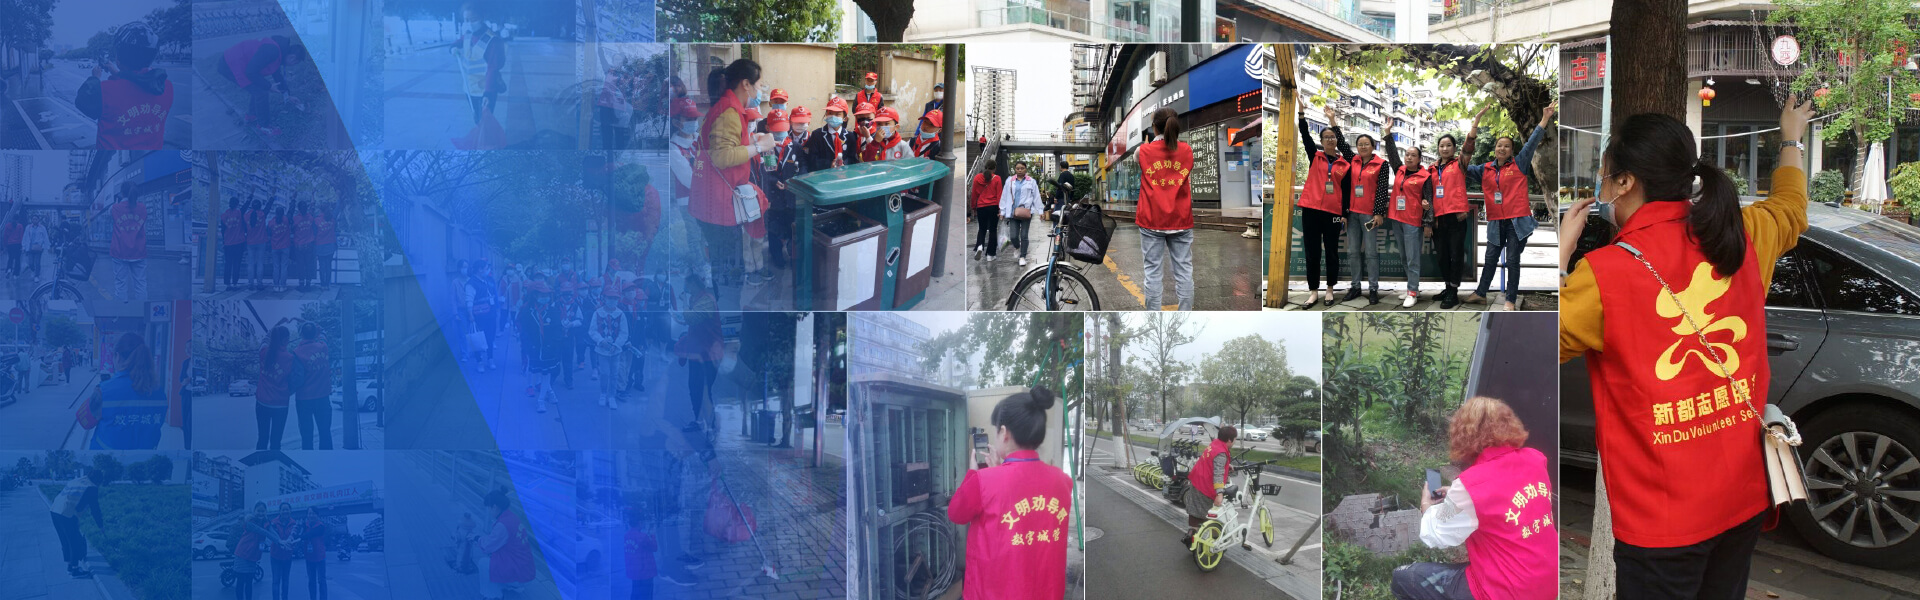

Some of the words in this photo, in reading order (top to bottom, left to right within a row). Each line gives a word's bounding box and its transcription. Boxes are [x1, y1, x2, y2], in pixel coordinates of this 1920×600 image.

[1146, 160, 1189, 178] 文明劝导员
[1653, 374, 1756, 425] 新都志愿服
[1690, 415, 1736, 439] Volunteer
[1001, 494, 1068, 530] 文明劝导员
[1505, 481, 1551, 526] 文明劝导
[1011, 527, 1060, 546] 数字城管
